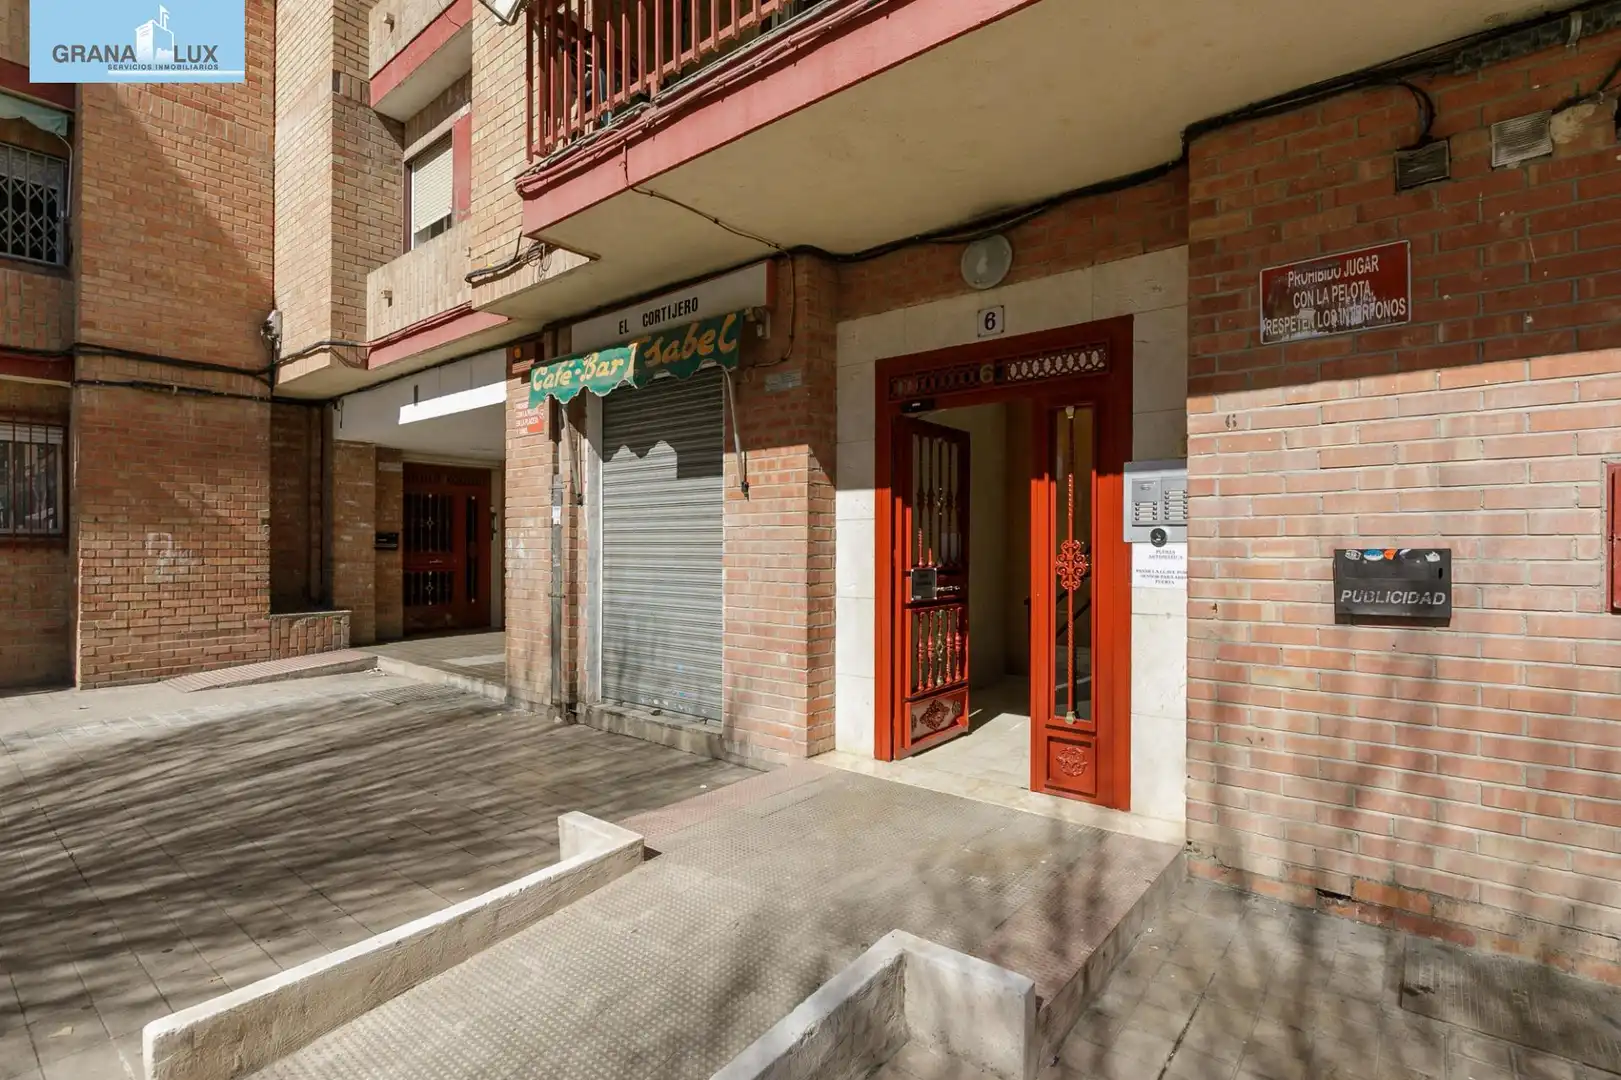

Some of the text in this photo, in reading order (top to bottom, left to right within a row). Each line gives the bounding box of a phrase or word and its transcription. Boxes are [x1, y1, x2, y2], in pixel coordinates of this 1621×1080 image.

[1343, 254, 1380, 278] JUGAR
[1293, 288, 1315, 309] CON
[1316, 286, 1330, 305] LA
[618, 296, 699, 335] EL CORTIJERO
[984, 311, 996, 331] 6
[1340, 589, 1446, 605] PUBLICIDAD
